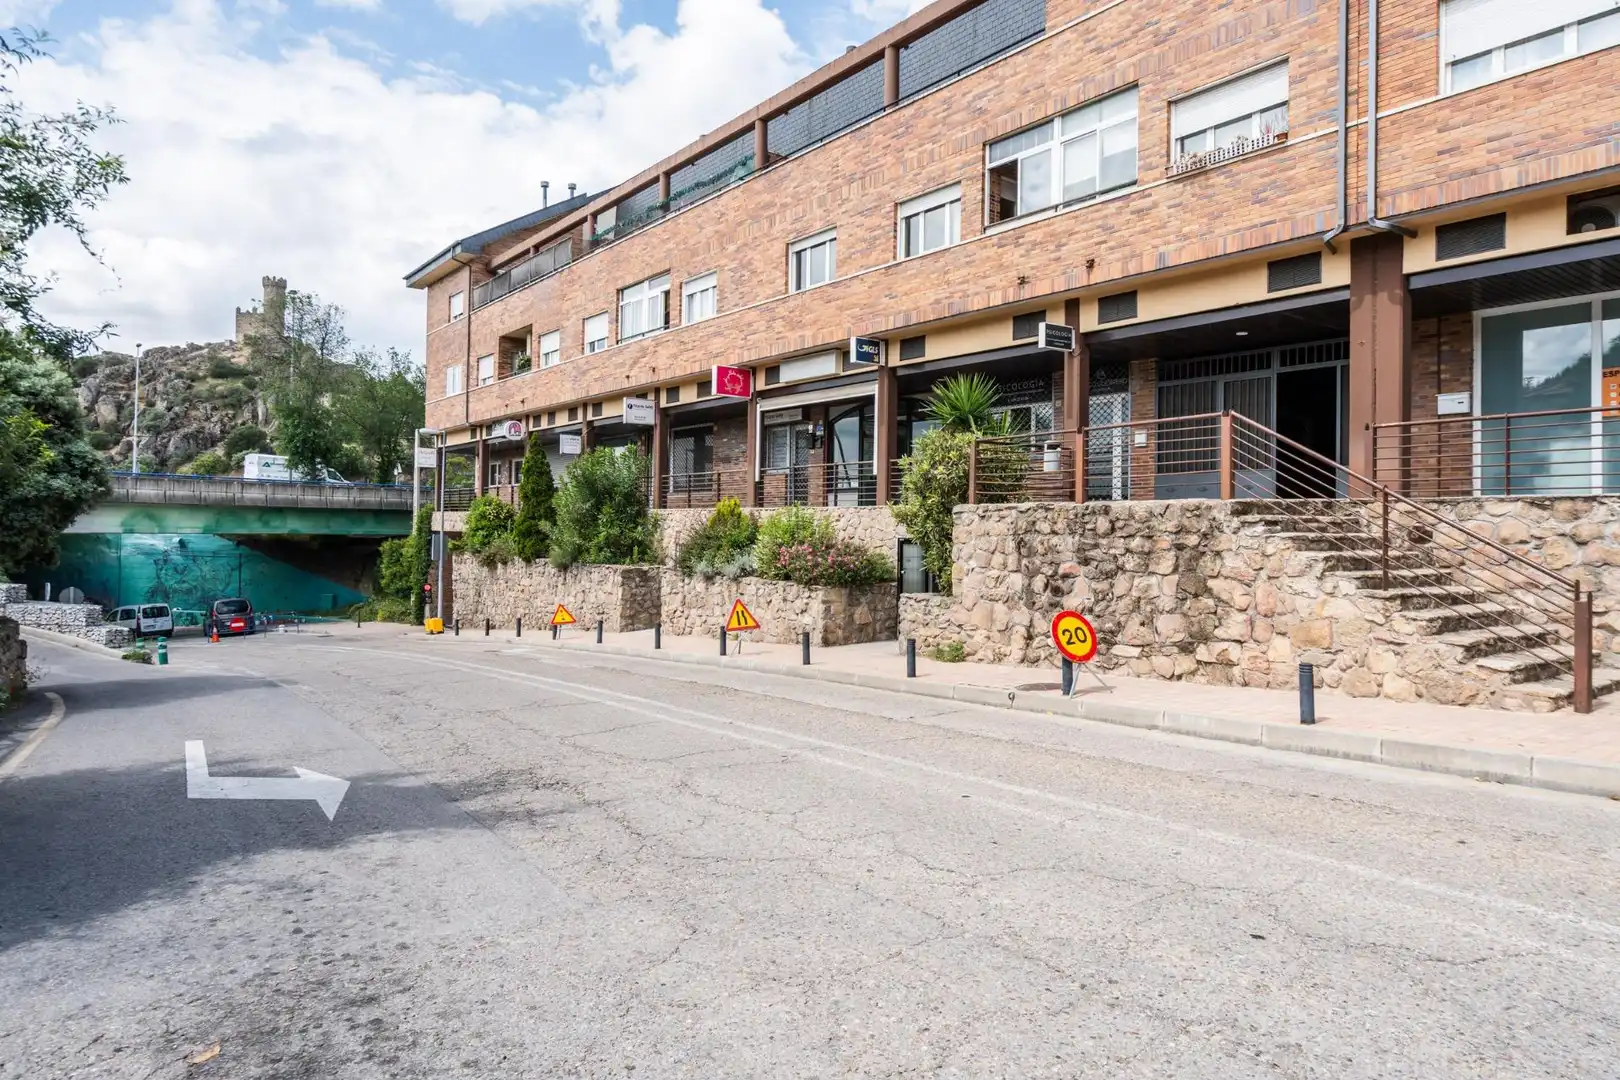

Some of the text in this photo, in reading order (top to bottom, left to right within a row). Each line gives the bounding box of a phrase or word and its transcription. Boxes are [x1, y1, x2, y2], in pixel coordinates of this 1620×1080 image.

[868, 345, 878, 353] GLS
[997, 379, 1044, 392] SICOLOGIA
[1061, 627, 1088, 646] 20
